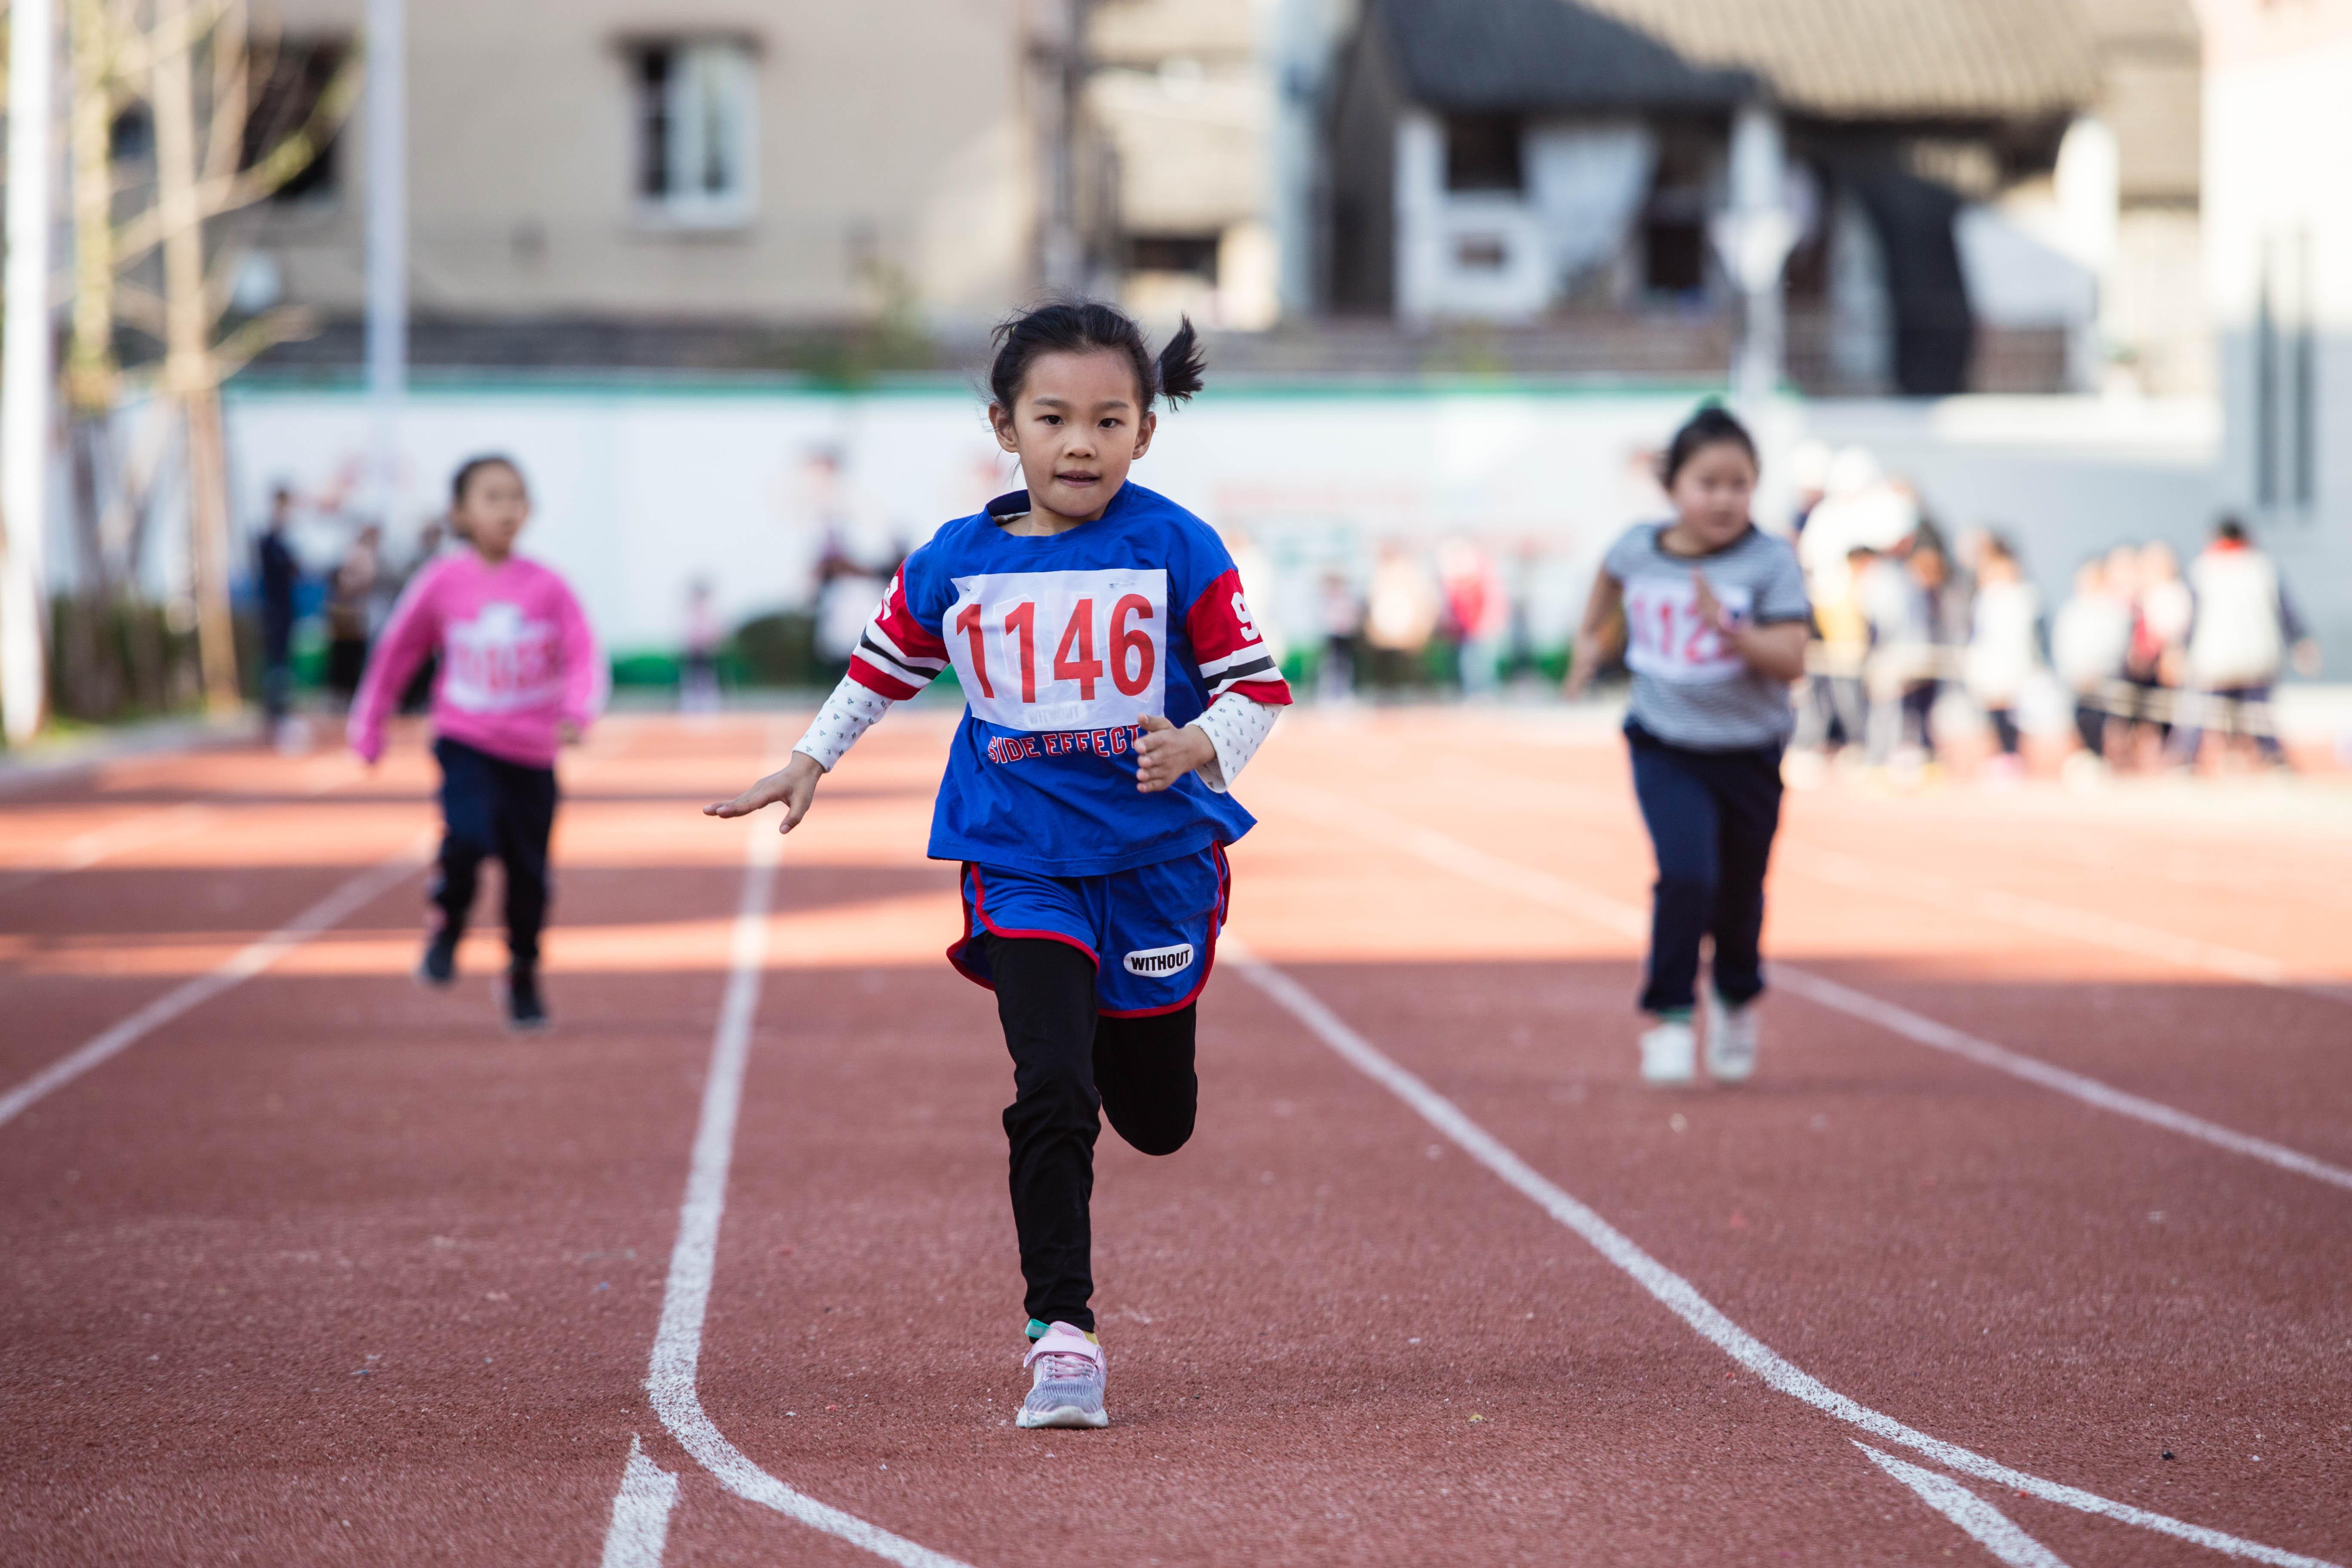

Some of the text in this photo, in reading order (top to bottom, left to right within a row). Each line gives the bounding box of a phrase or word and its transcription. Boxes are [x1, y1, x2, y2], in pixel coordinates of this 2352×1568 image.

[957, 593, 1155, 703] 1146
[988, 724, 1140, 763] SIDE EFFECT
[1131, 949, 1190, 971] WITHOUT
